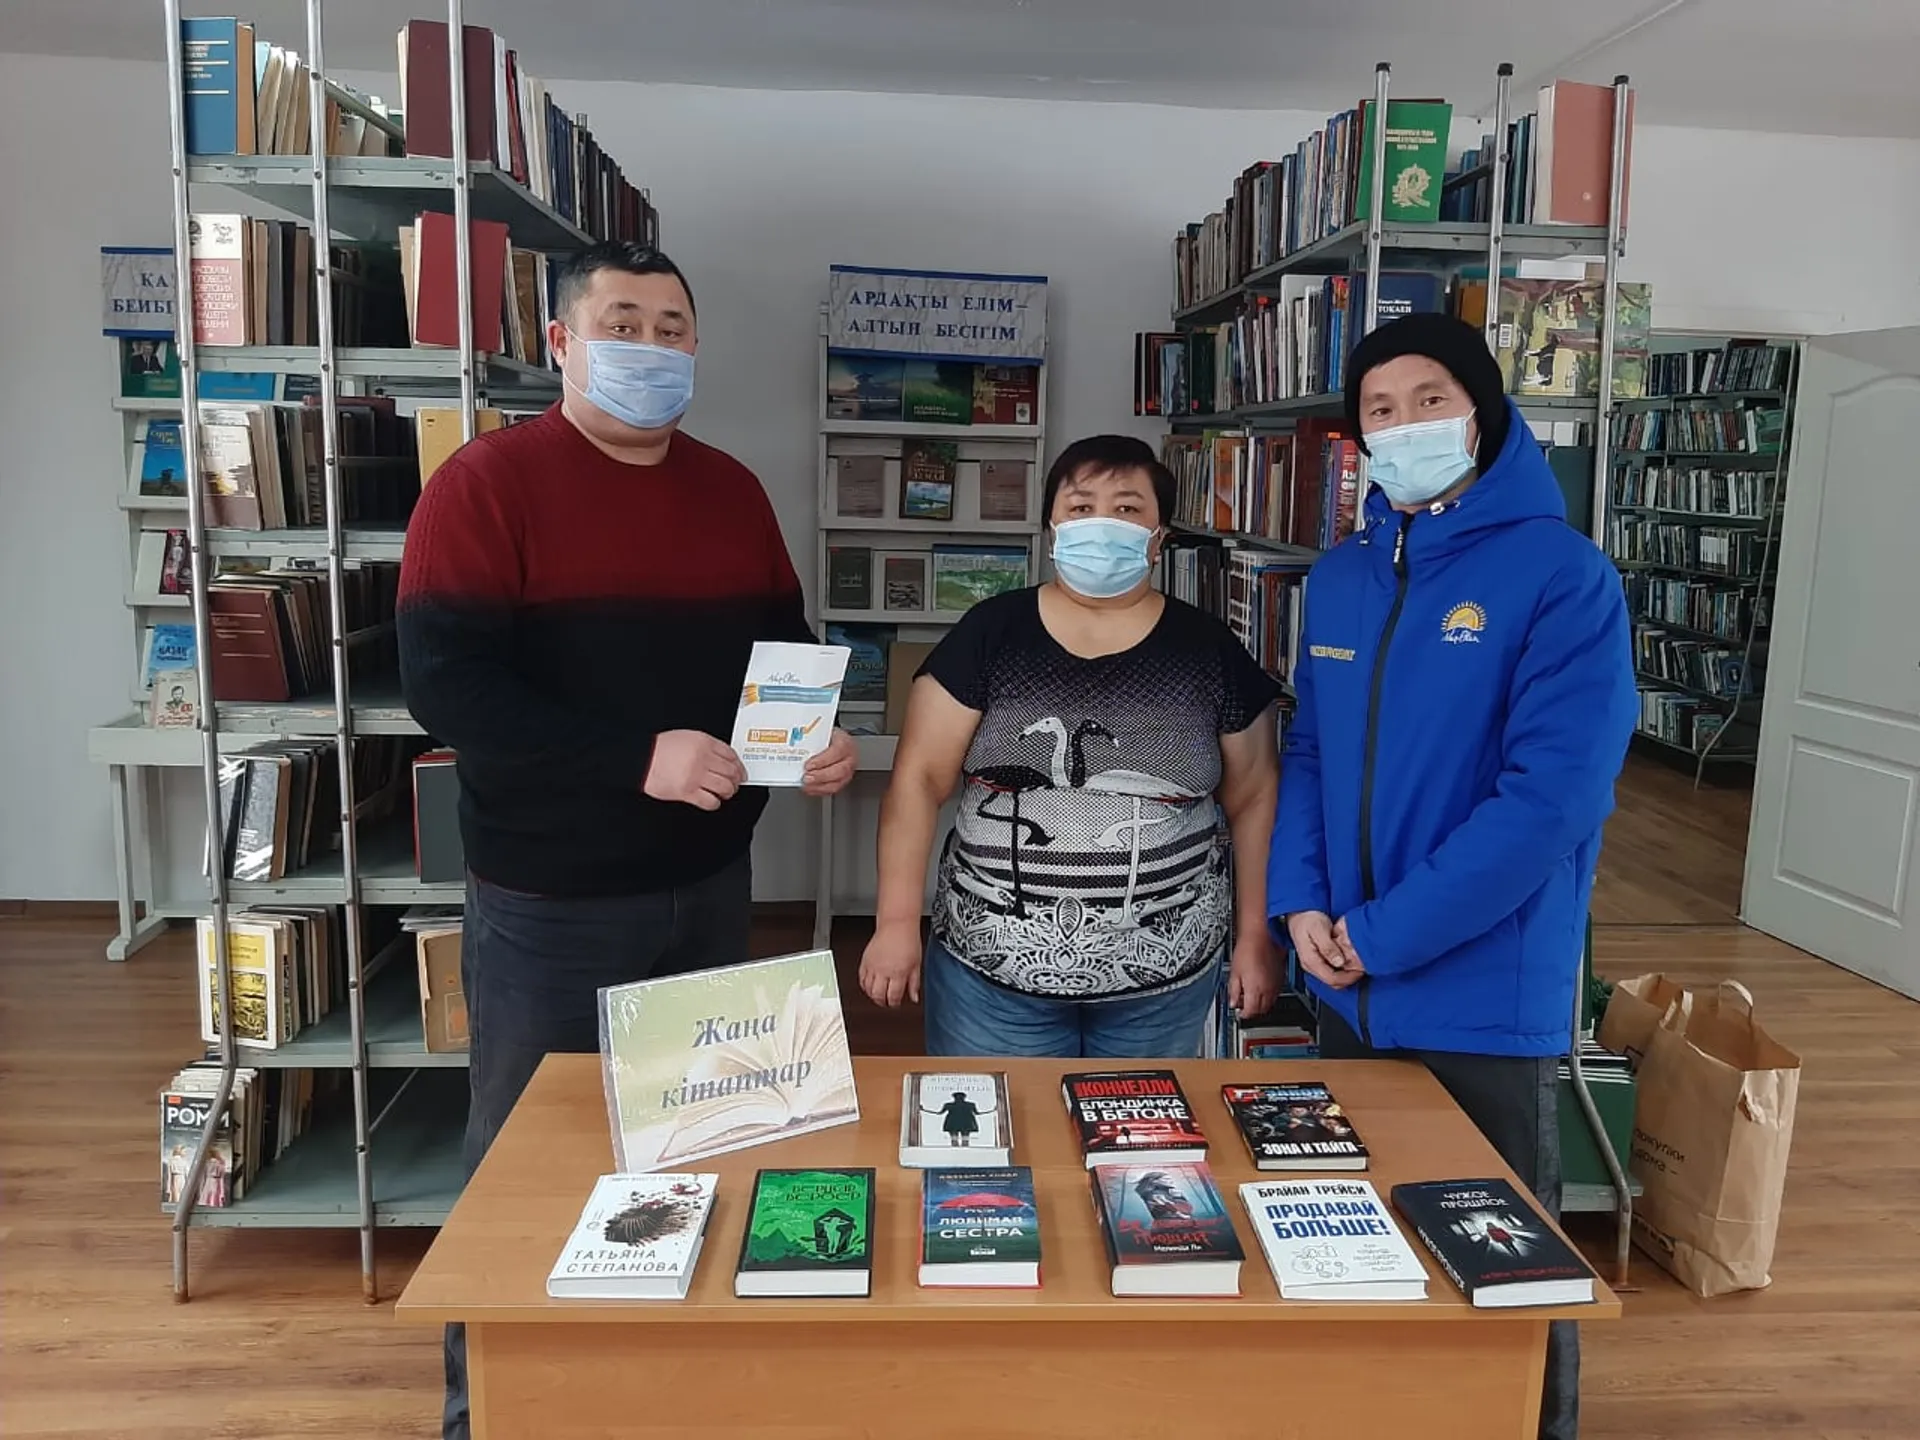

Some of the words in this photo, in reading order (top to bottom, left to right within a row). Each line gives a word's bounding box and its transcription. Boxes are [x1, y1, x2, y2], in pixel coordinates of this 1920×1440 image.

[849, 290, 947, 311] АРДАҚТЫ
[848, 319, 921, 336] АЛТЫН
[935, 323, 1018, 341] БЕСІГІМ
[692, 1014, 776, 1048] Жаңа
[661, 1059, 811, 1109] кітаптар
[1082, 1080, 1176, 1097] КОННЕЛЛИ
[1079, 1098, 1184, 1110] БЛОНДИНКА
[1082, 1111, 1098, 1122] В
[1102, 1108, 1189, 1121] БЕТОНЕ
[1262, 1142, 1301, 1155] ЗОНА
[1302, 1142, 1313, 1154] И
[1312, 1140, 1359, 1154] ТАЙГА
[1257, 1185, 1310, 1198] БРАЙАН
[1314, 1184, 1367, 1196] ТРЕЙСИ
[1443, 1190, 1490, 1199] ЧУЖОЕ
[1265, 1200, 1380, 1219] ПРОДАВАЙ
[1440, 1198, 1510, 1209] ПРОШЛОЕ
[939, 1216, 1024, 1225] ЛЮБИМАЯ
[940, 1227, 1024, 1239] СЕСТРА
[1272, 1219, 1391, 1239] БОЛЬШЕ!
[573, 1249, 657, 1260] ТАТЬЯНА
[566, 1261, 679, 1274] СТЕПАНОВА
